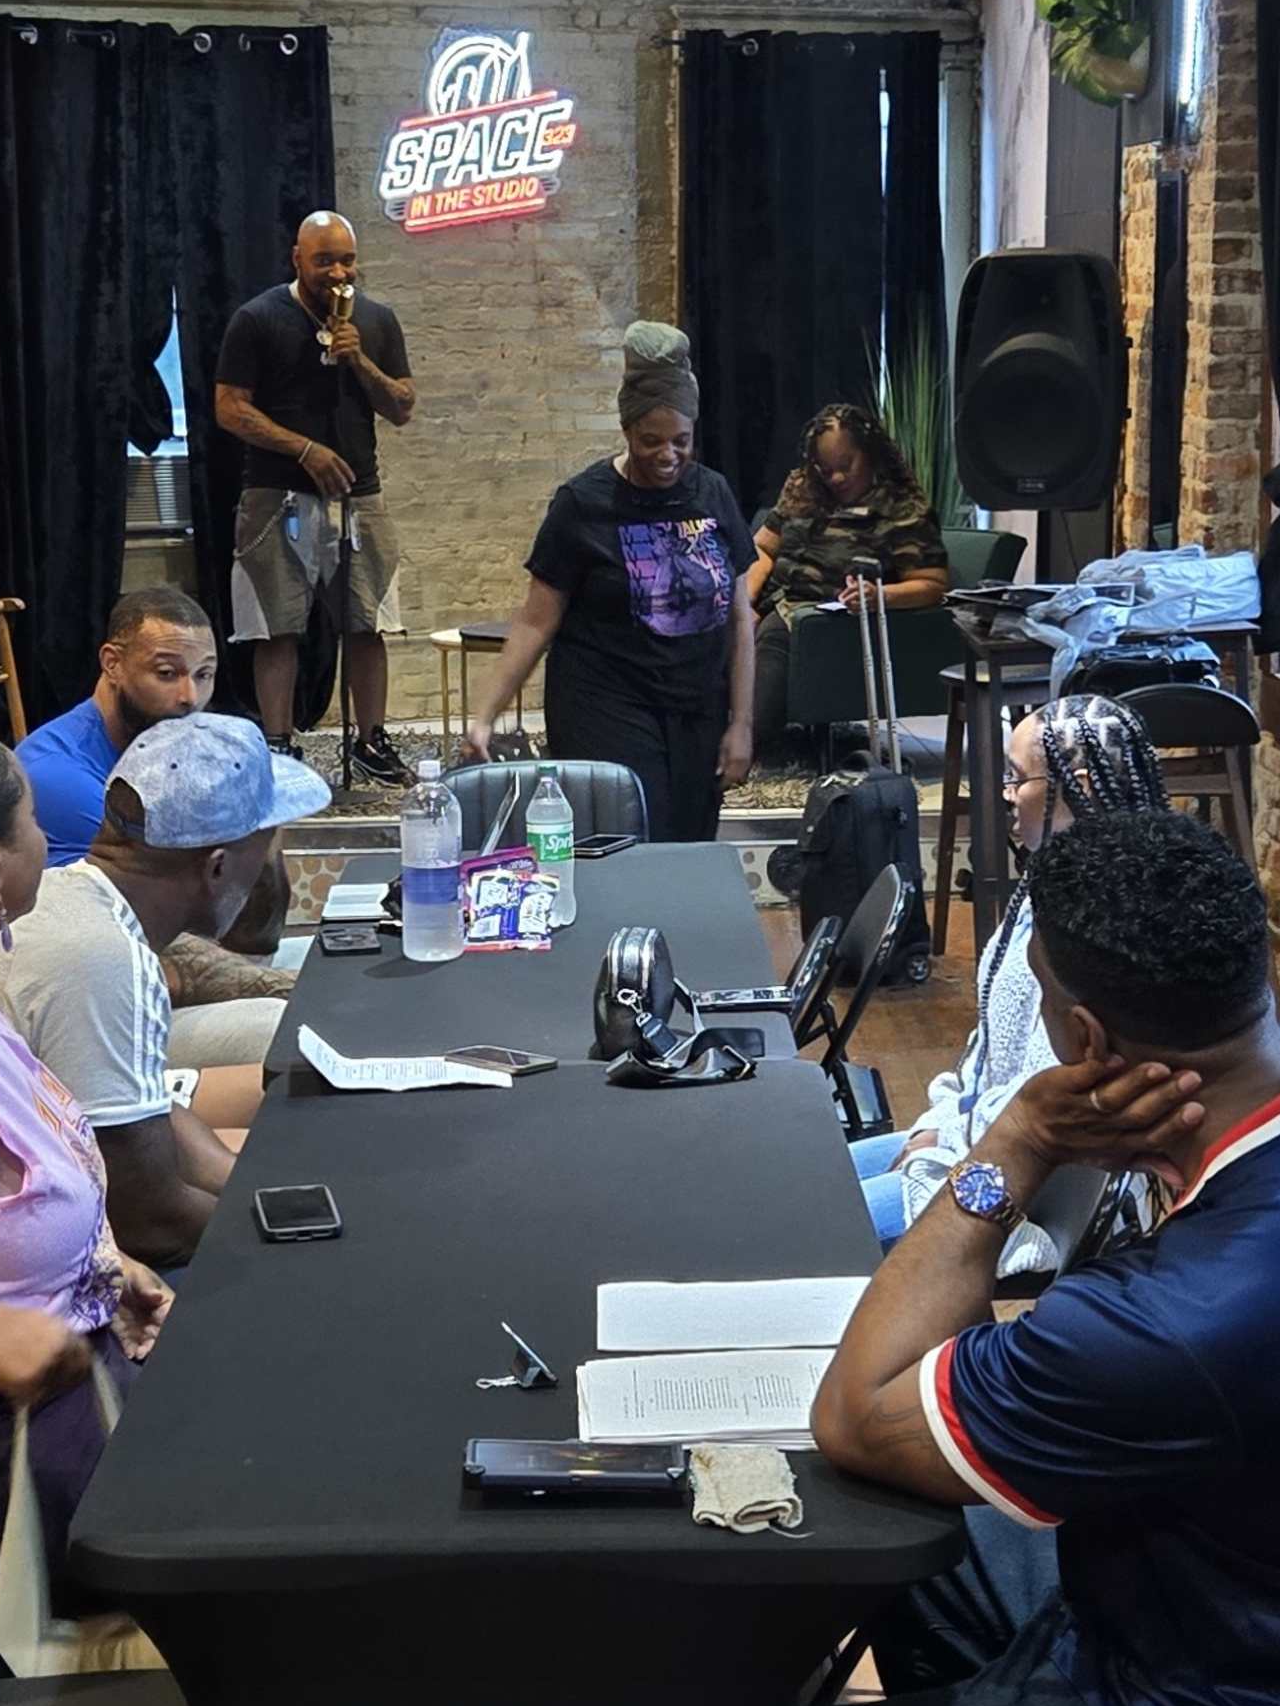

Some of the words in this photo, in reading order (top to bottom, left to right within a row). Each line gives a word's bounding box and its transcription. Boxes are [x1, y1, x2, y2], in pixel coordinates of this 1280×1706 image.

[381, 99, 573, 199] SPACE
[410, 196, 431, 218] IN
[434, 188, 471, 212] THE
[472, 177, 539, 207] STUDIO
